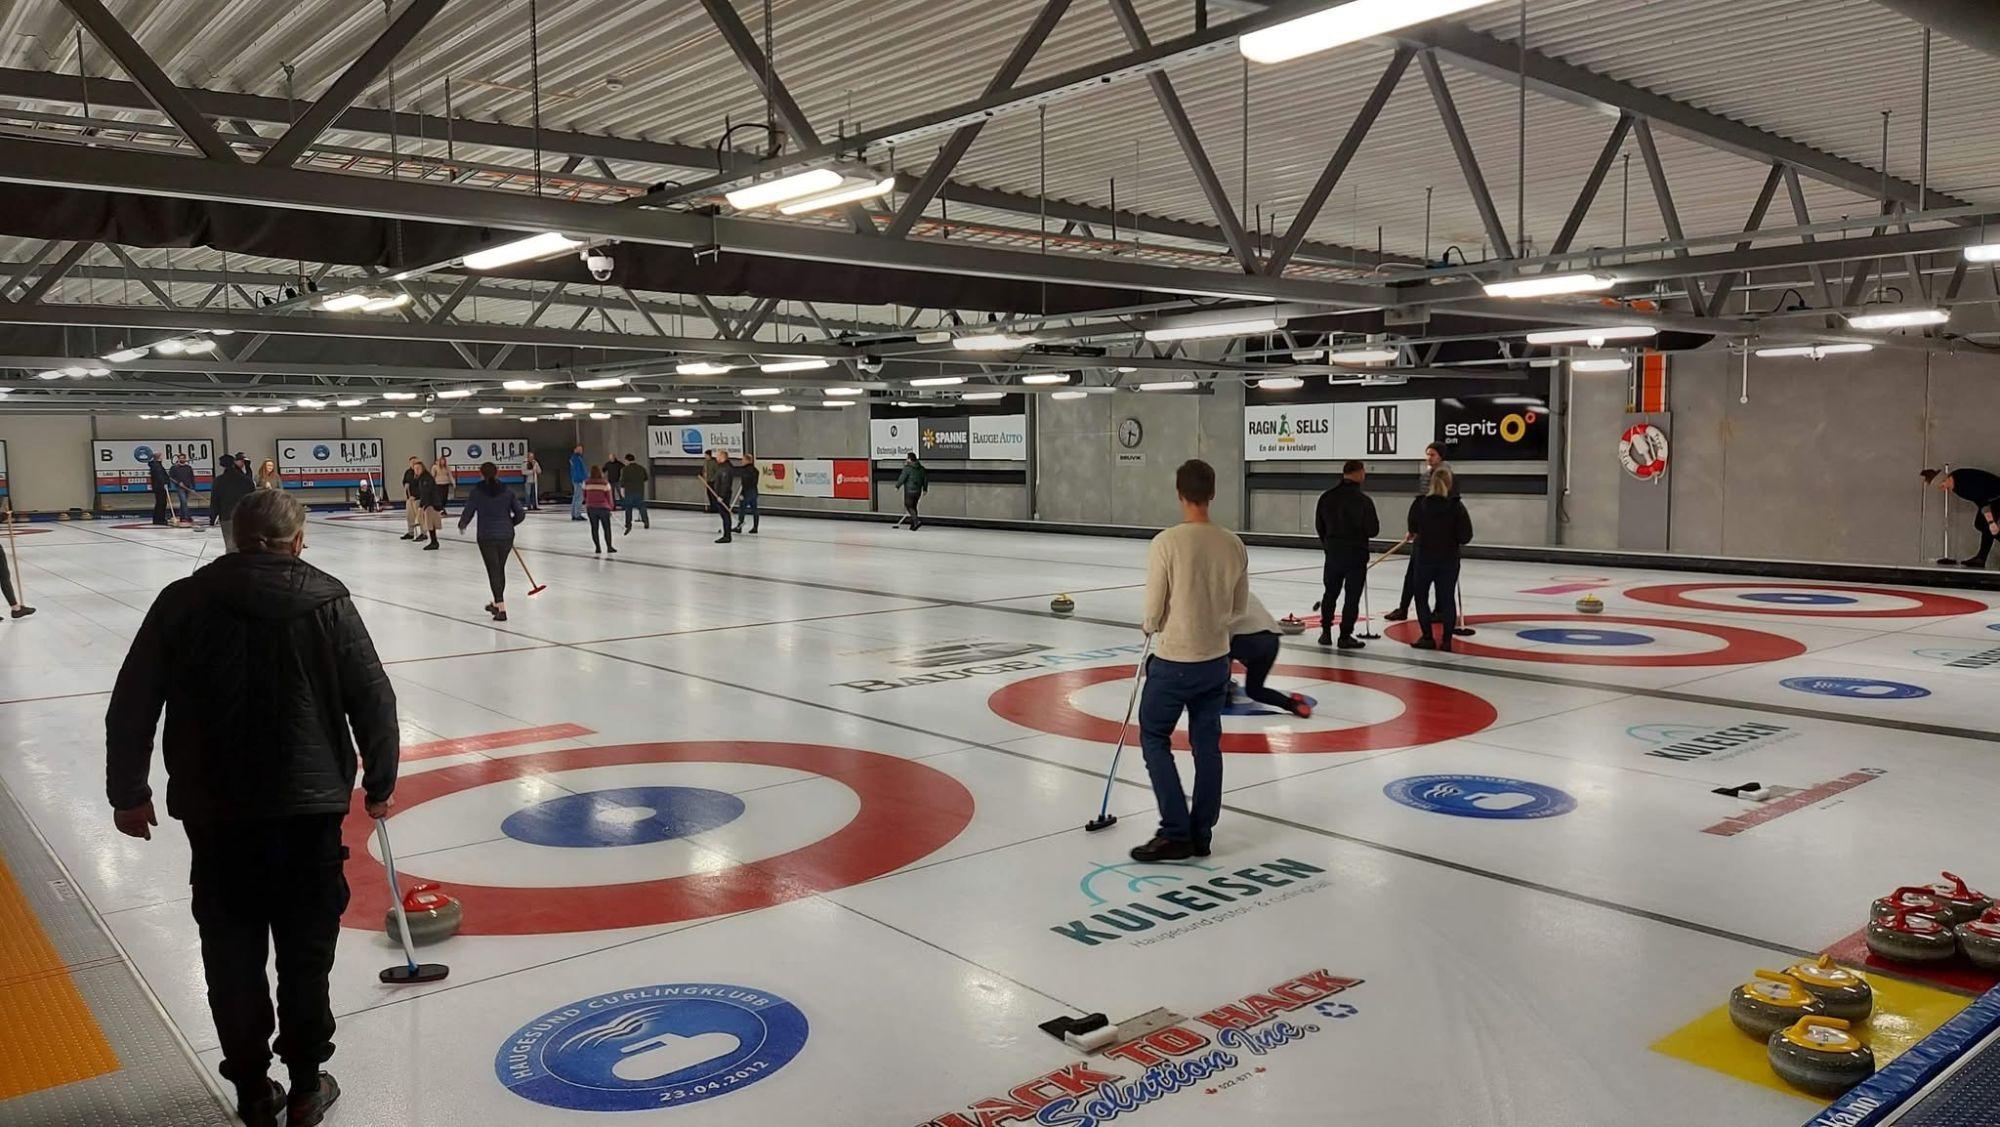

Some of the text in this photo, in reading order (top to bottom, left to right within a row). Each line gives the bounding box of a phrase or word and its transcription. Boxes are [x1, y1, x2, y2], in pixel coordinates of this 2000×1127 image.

[1248, 419, 1329, 435] RAGN SELLS
[1445, 419, 1497, 435] serit
[654, 431, 673, 446] MM
[935, 431, 968, 444] SPANNE
[972, 431, 1023, 444] BAUGE AUTO
[101, 449, 113, 461] B
[165, 443, 208, 460] RICO
[283, 447, 296, 459] C
[340, 442, 377, 458] RICO
[441, 446, 452, 457] D
[491, 442, 524, 457] RICO
[831, 658, 1045, 694] BAUGE
[1644, 722, 1790, 761] KULEISEN
[1050, 858, 1327, 946] KULEISEN
[587, 986, 771, 1009] CURLINGKLUBB
[1103, 1024, 1210, 1070] TO
[1193, 968, 1365, 1032] HACK
[507, 1007, 582, 1080] HAUGESUND
[1219, 1019, 1321, 1056] Inc.
[659, 1060, 770, 1102] 23.04.2012
